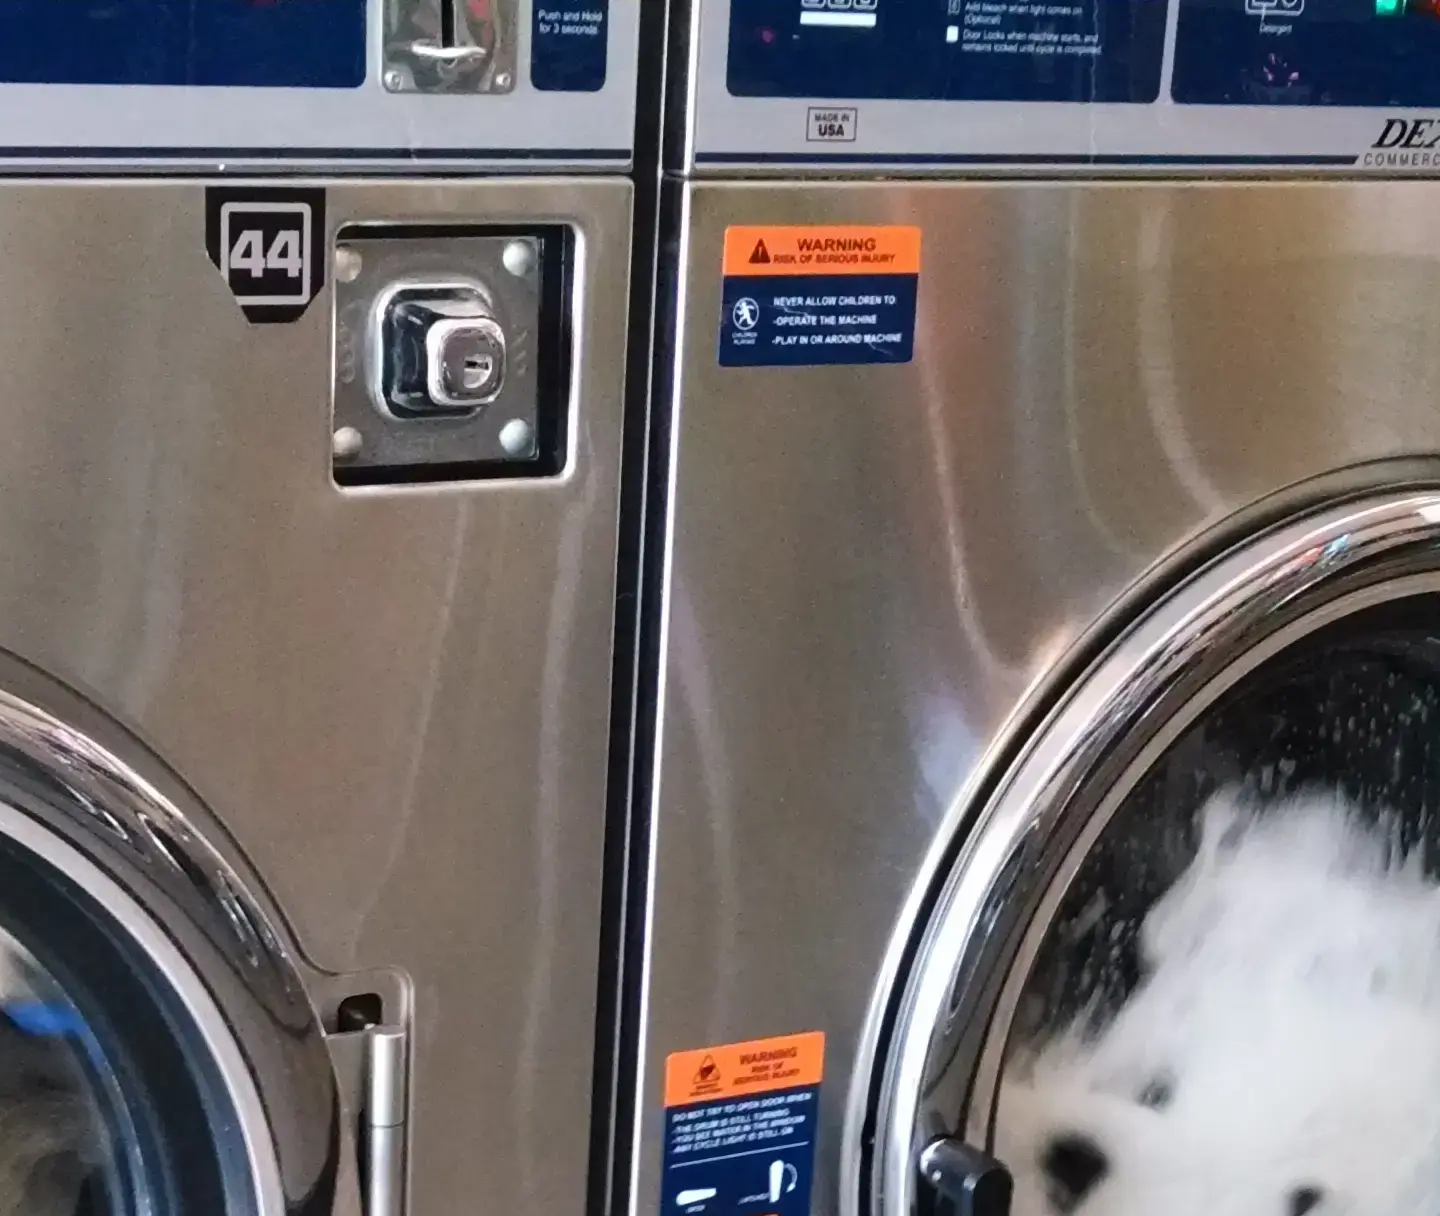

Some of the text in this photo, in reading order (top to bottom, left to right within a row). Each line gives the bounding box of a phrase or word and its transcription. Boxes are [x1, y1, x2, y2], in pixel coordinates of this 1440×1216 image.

[539, 9, 561, 21] Push
[563, 11, 580, 21] and
[553, 23, 560, 34] 3
[562, 25, 598, 35] seconds
[818, 123, 845, 137] USA
[796, 237, 877, 252] WARNING
[229, 229, 302, 279] 44
[773, 254, 797, 265] RISK
[799, 254, 813, 264] OF
[816, 254, 859, 264] SERIOUS
[773, 295, 897, 306] NEVER ALLOW CHILDREN TO
[820, 315, 837, 326] THE
[838, 314, 878, 325] MACHINE
[799, 335, 809, 345] IN
[810, 335, 824, 345] OR
[825, 333, 862, 344] AROUND
[863, 332, 902, 343] MACHINE
[740, 1046, 798, 1065] WARNING
